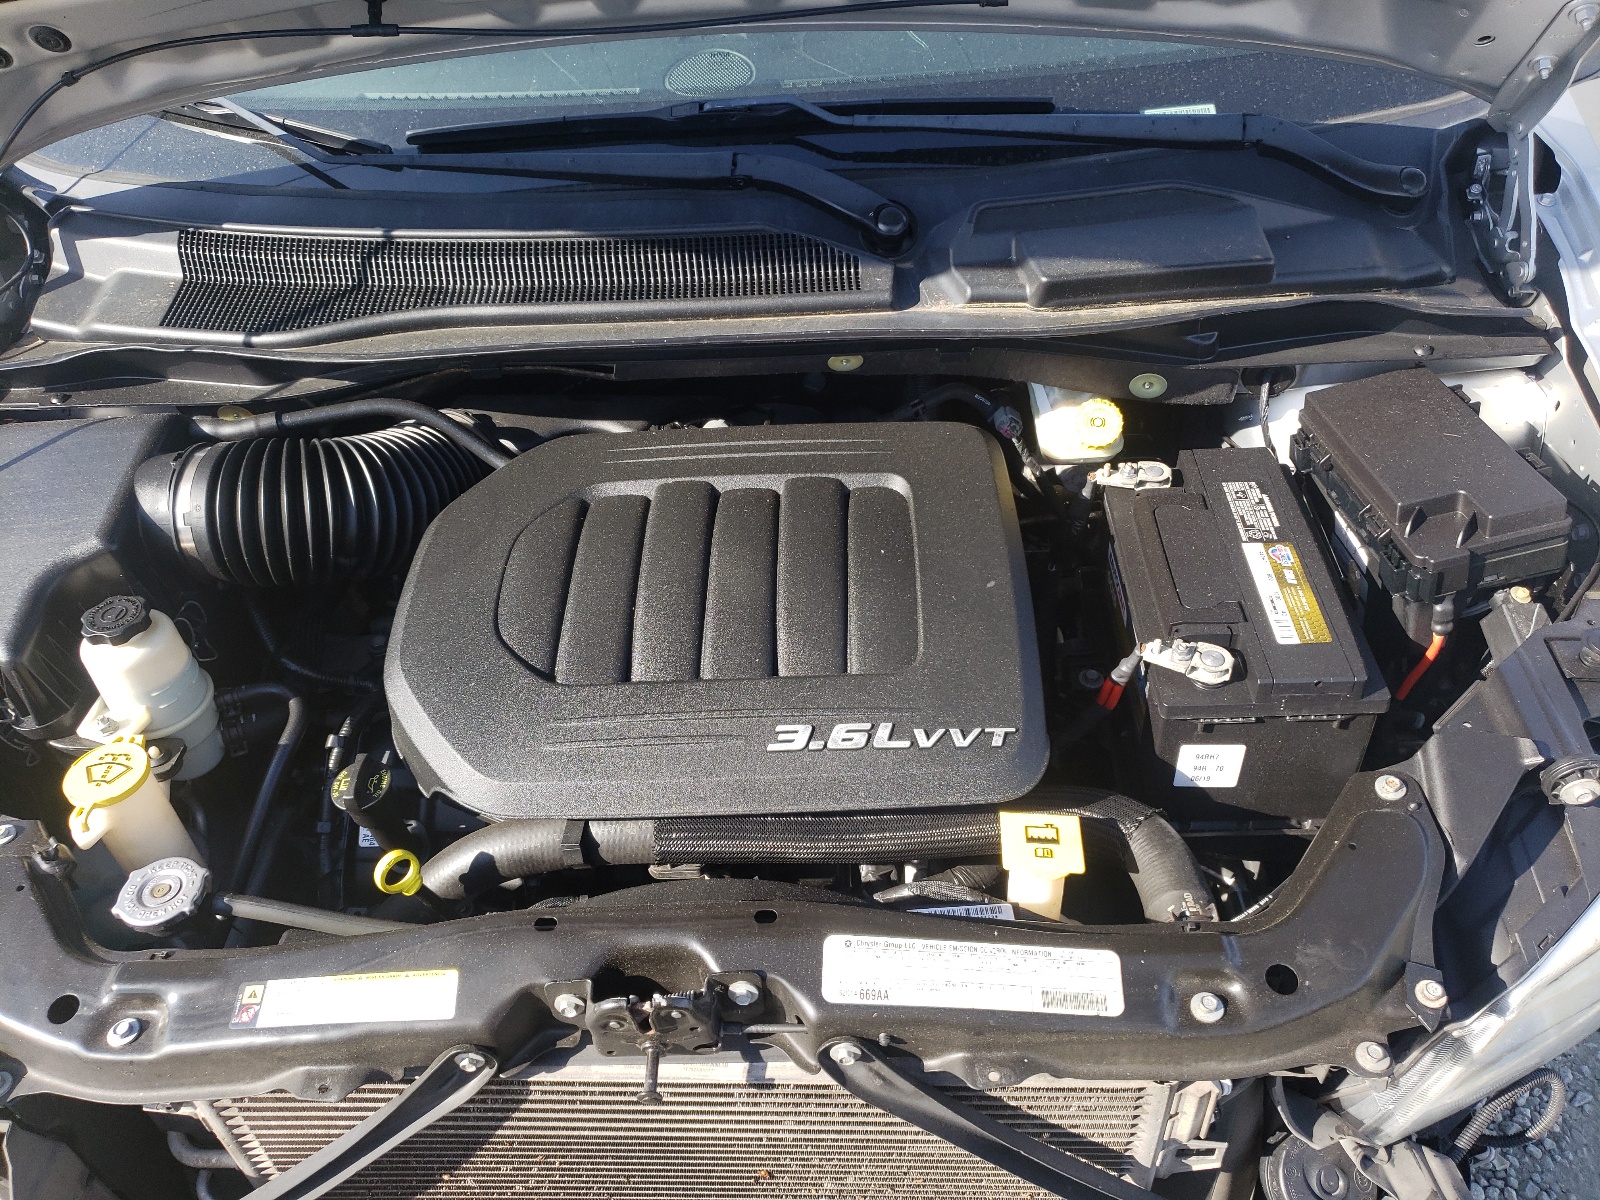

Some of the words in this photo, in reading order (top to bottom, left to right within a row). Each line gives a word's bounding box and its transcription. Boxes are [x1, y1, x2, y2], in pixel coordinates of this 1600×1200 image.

[883, 940, 903, 951] Group
[904, 941, 916, 950] LLC
[920, 943, 947, 952] VEHICLE
